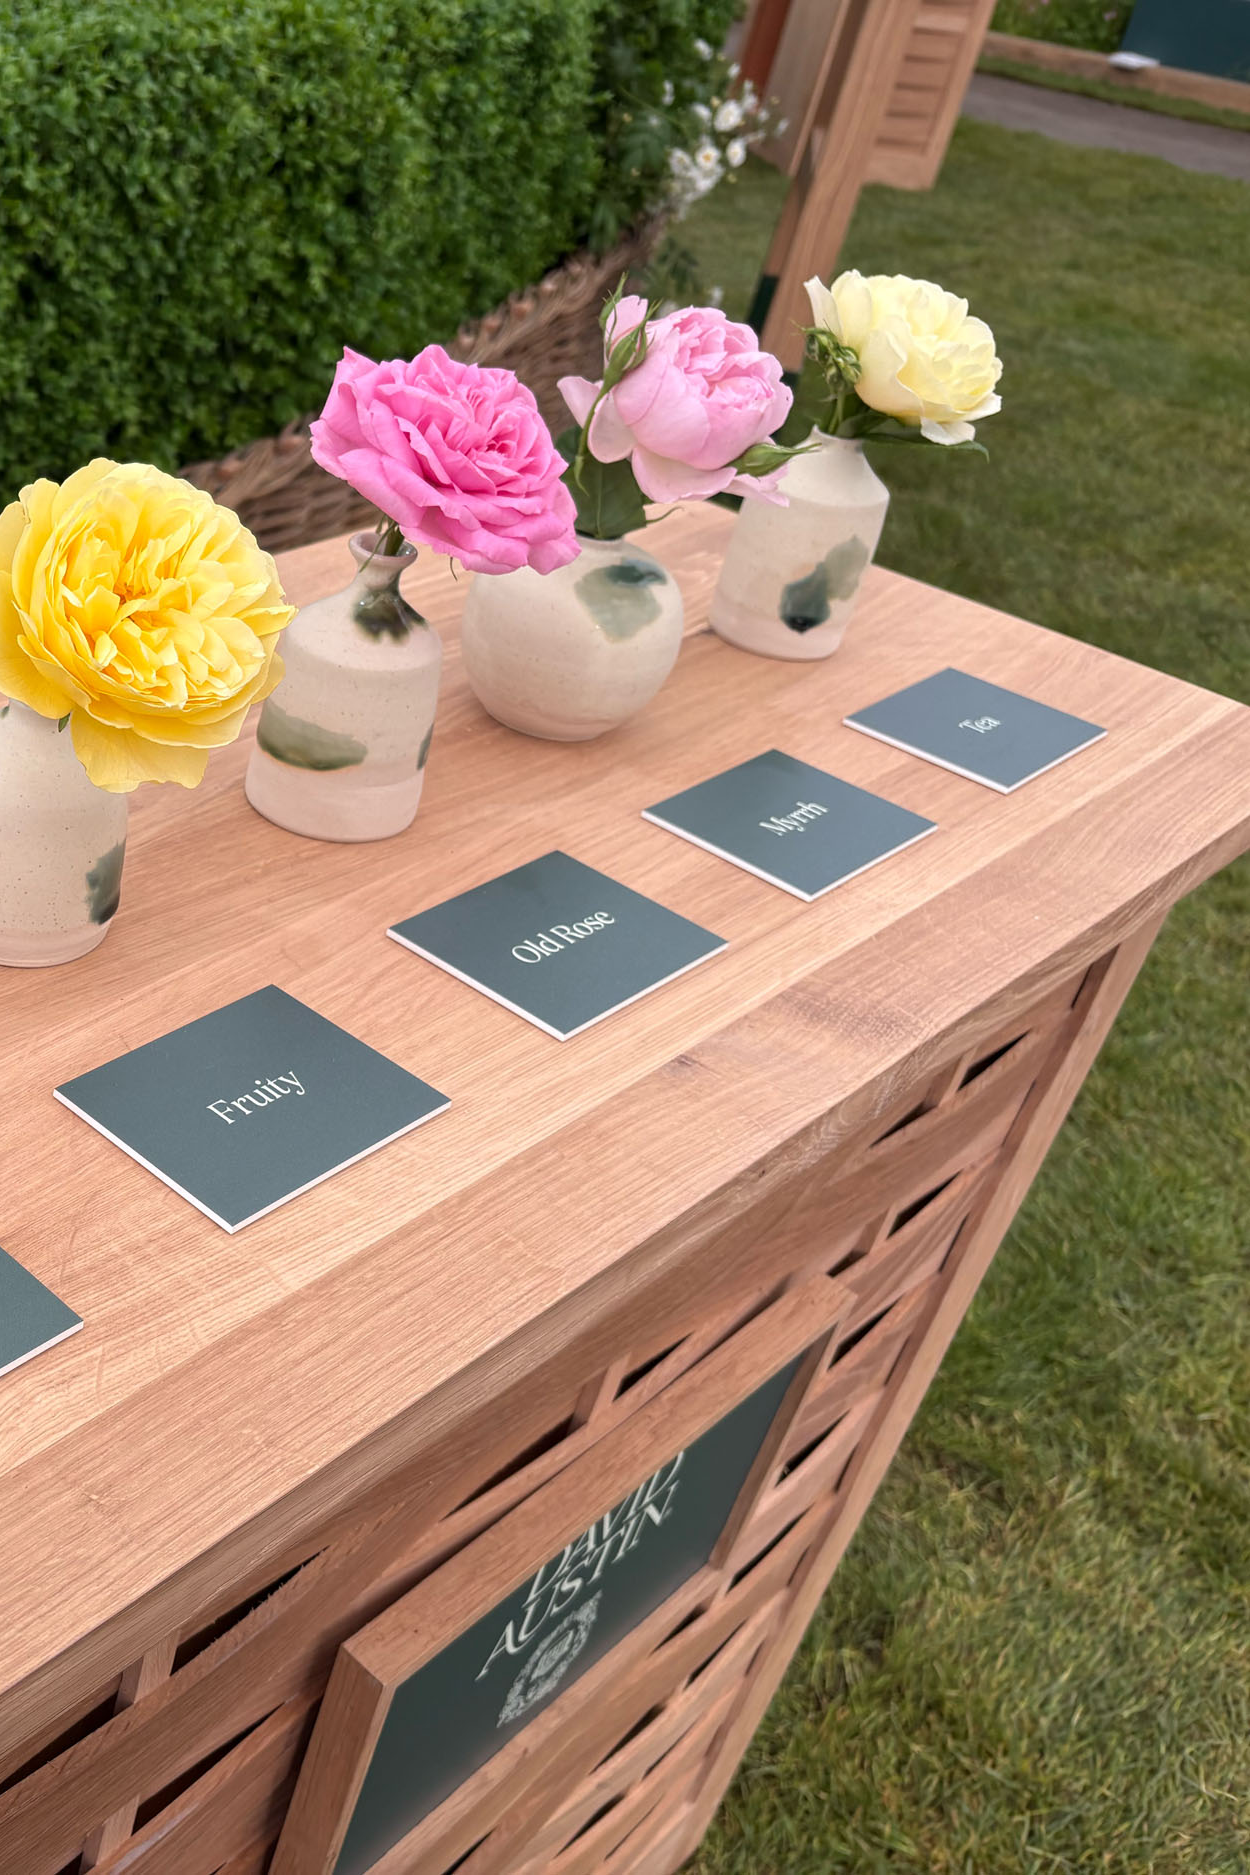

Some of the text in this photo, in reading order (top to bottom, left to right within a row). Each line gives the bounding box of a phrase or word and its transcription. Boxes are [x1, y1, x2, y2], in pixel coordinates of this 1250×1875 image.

[958, 716, 1001, 734] Tea
[758, 801, 829, 836] Myrrh
[511, 911, 615, 964] Old Rose
[206, 1070, 306, 1125] Fruity
[474, 1479, 680, 1682] AUSTIN
